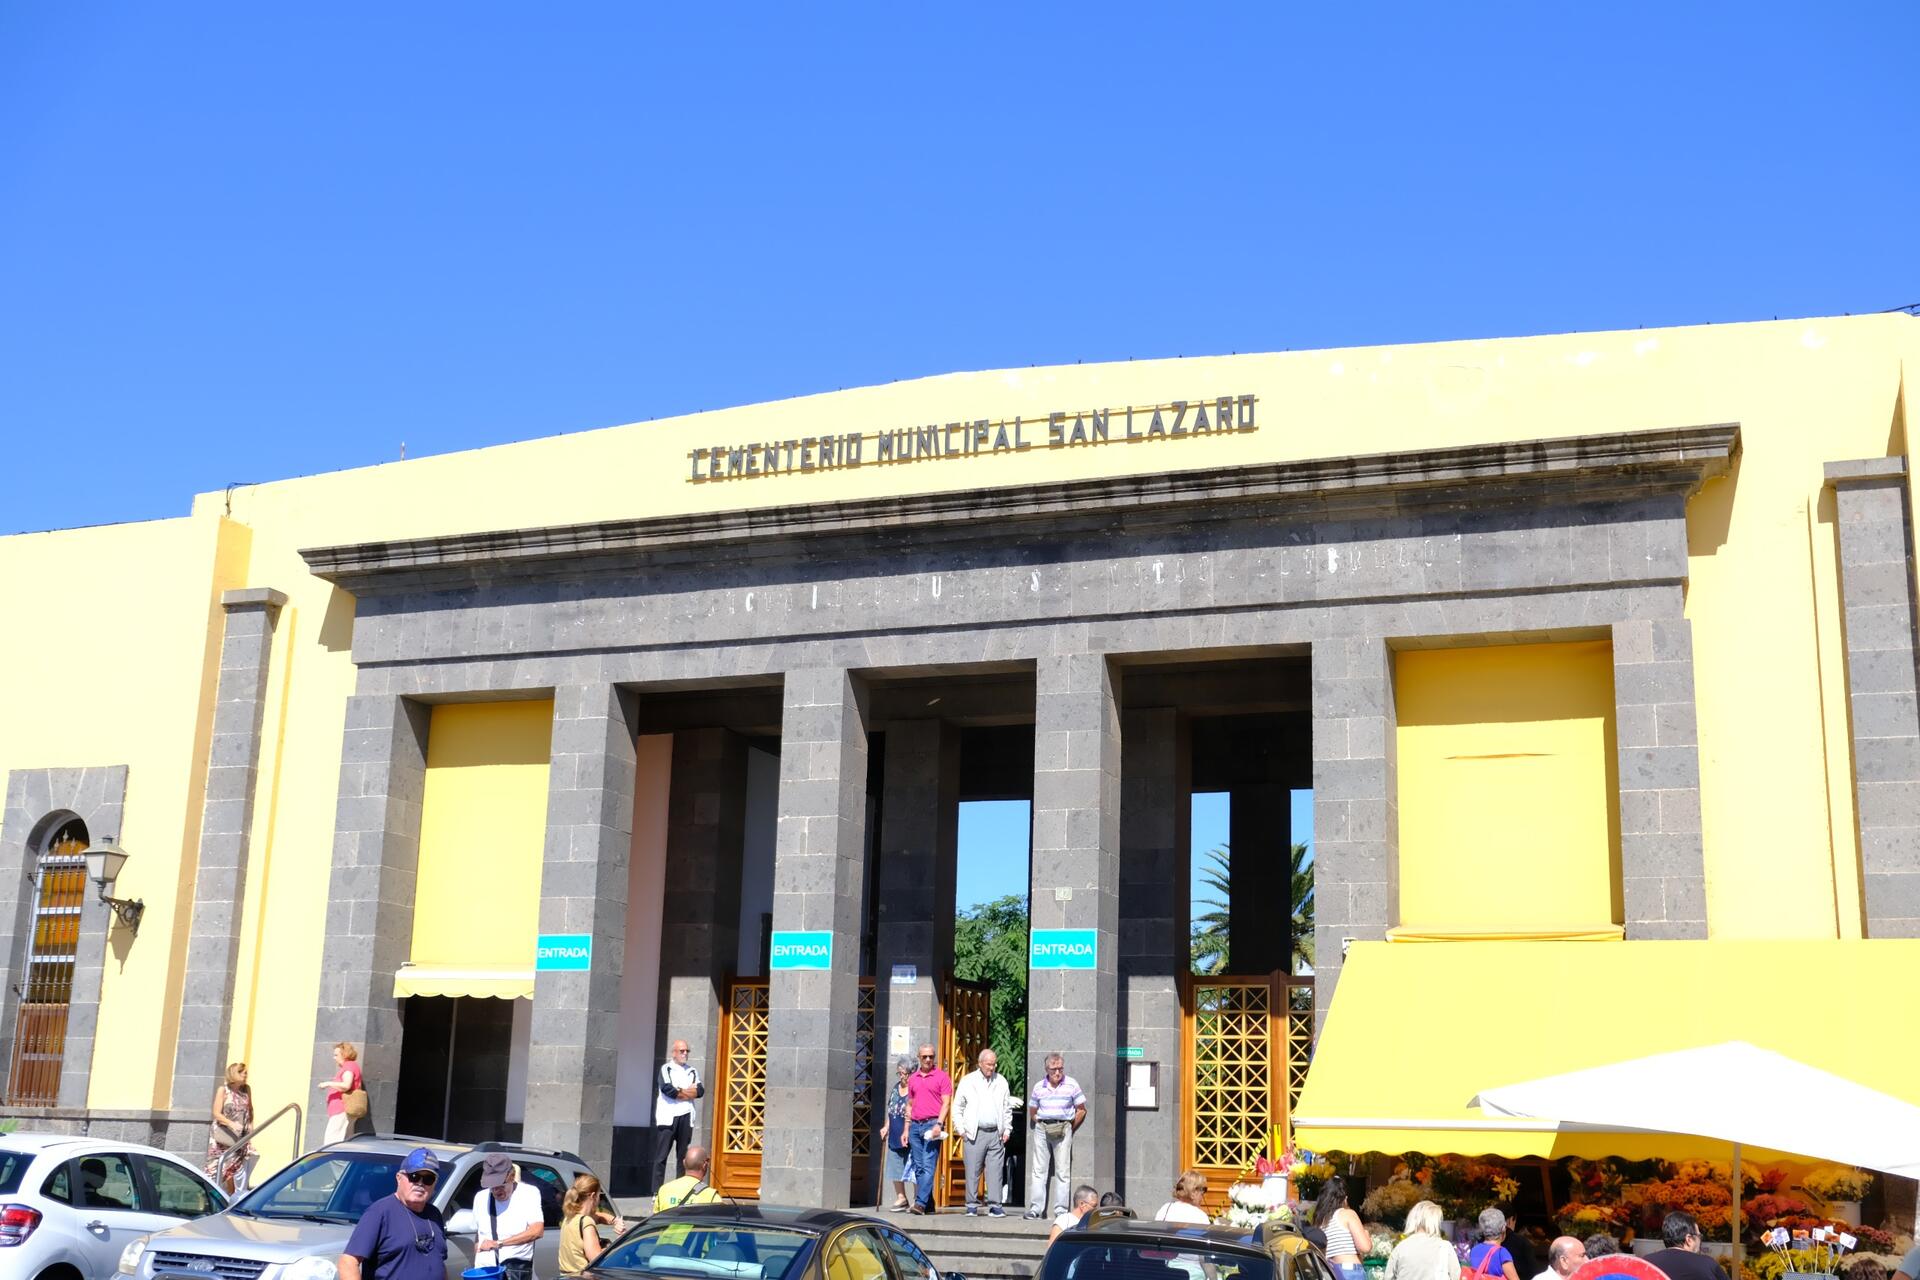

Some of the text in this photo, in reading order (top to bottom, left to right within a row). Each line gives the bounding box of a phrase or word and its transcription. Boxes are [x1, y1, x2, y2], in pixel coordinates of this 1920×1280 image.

[692, 395, 1255, 482] CEMENTERIO MUNICIPAL SAN LAZARO
[539, 947, 588, 958] ENTRADA
[774, 945, 829, 956] ENTRADA
[1033, 943, 1093, 955] ENTRADA
